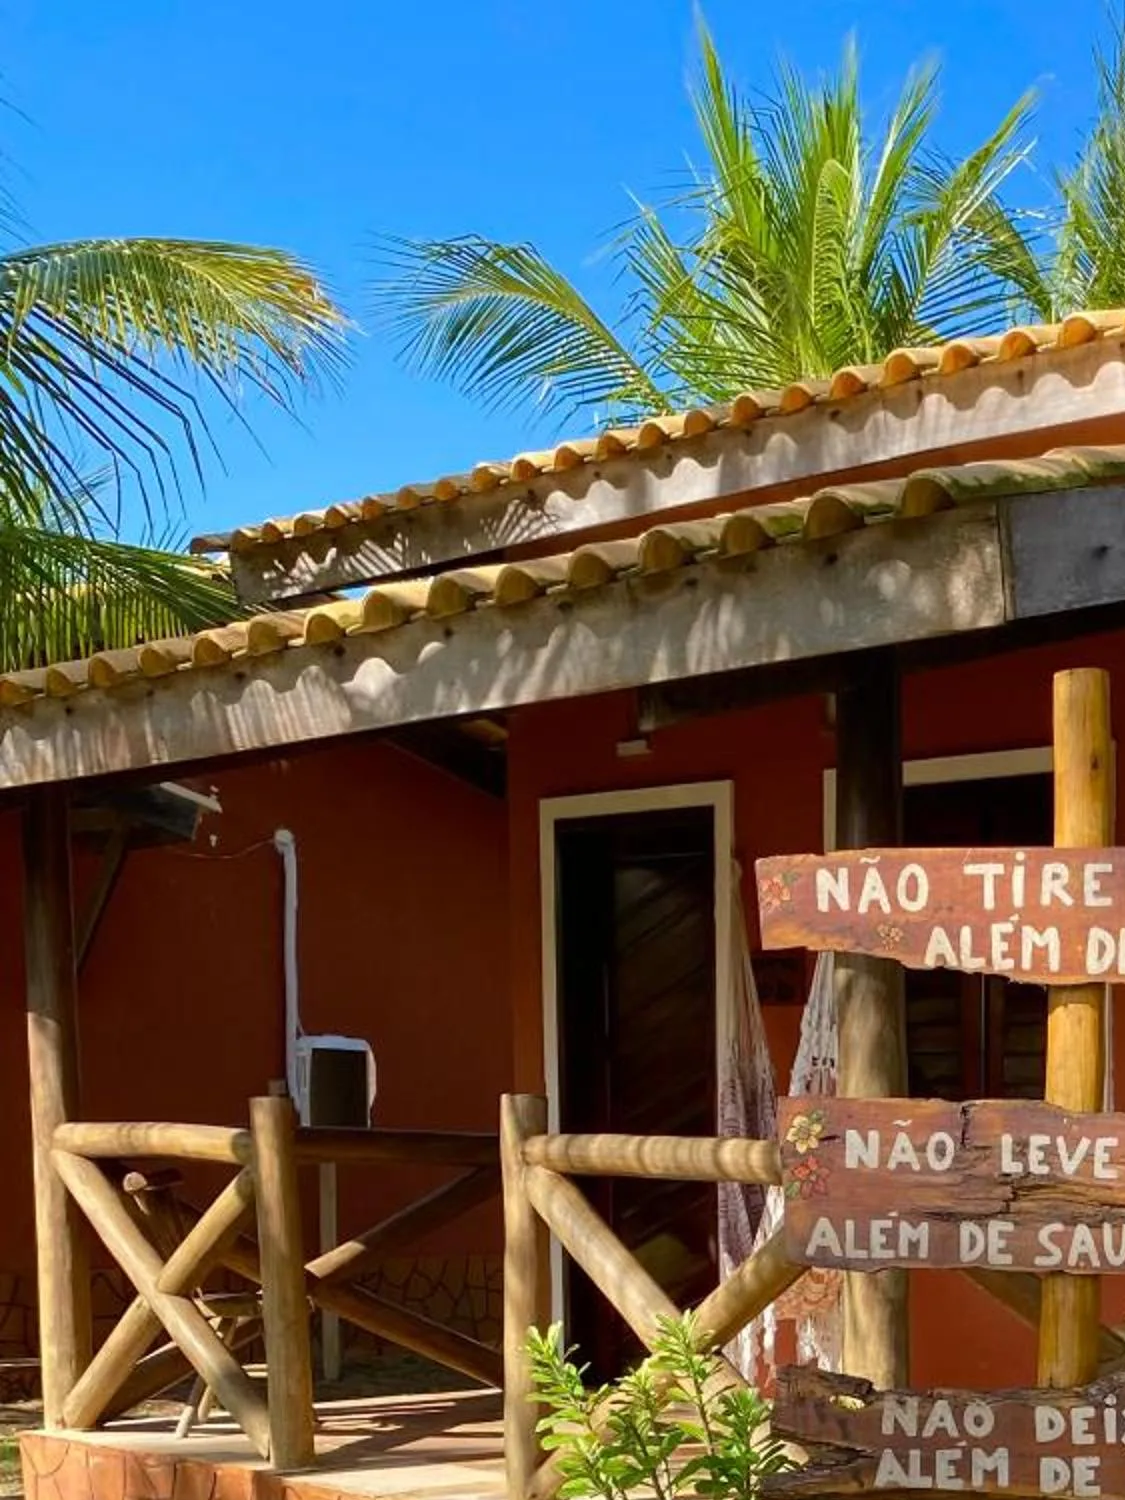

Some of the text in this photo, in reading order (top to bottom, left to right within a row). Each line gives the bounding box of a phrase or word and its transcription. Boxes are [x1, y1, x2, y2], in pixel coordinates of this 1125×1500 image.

[815, 855, 930, 914] NÃO
[924, 913, 1061, 973] ALÉM
[844, 1119, 955, 1172] NÃO
[1000, 1133, 1119, 1179] LEVE
[805, 1211, 929, 1260] ALÉM
[959, 1220, 1014, 1265] DE
[873, 1440, 1010, 1490] ALÉM
[1040, 1456, 1101, 1497] DE
